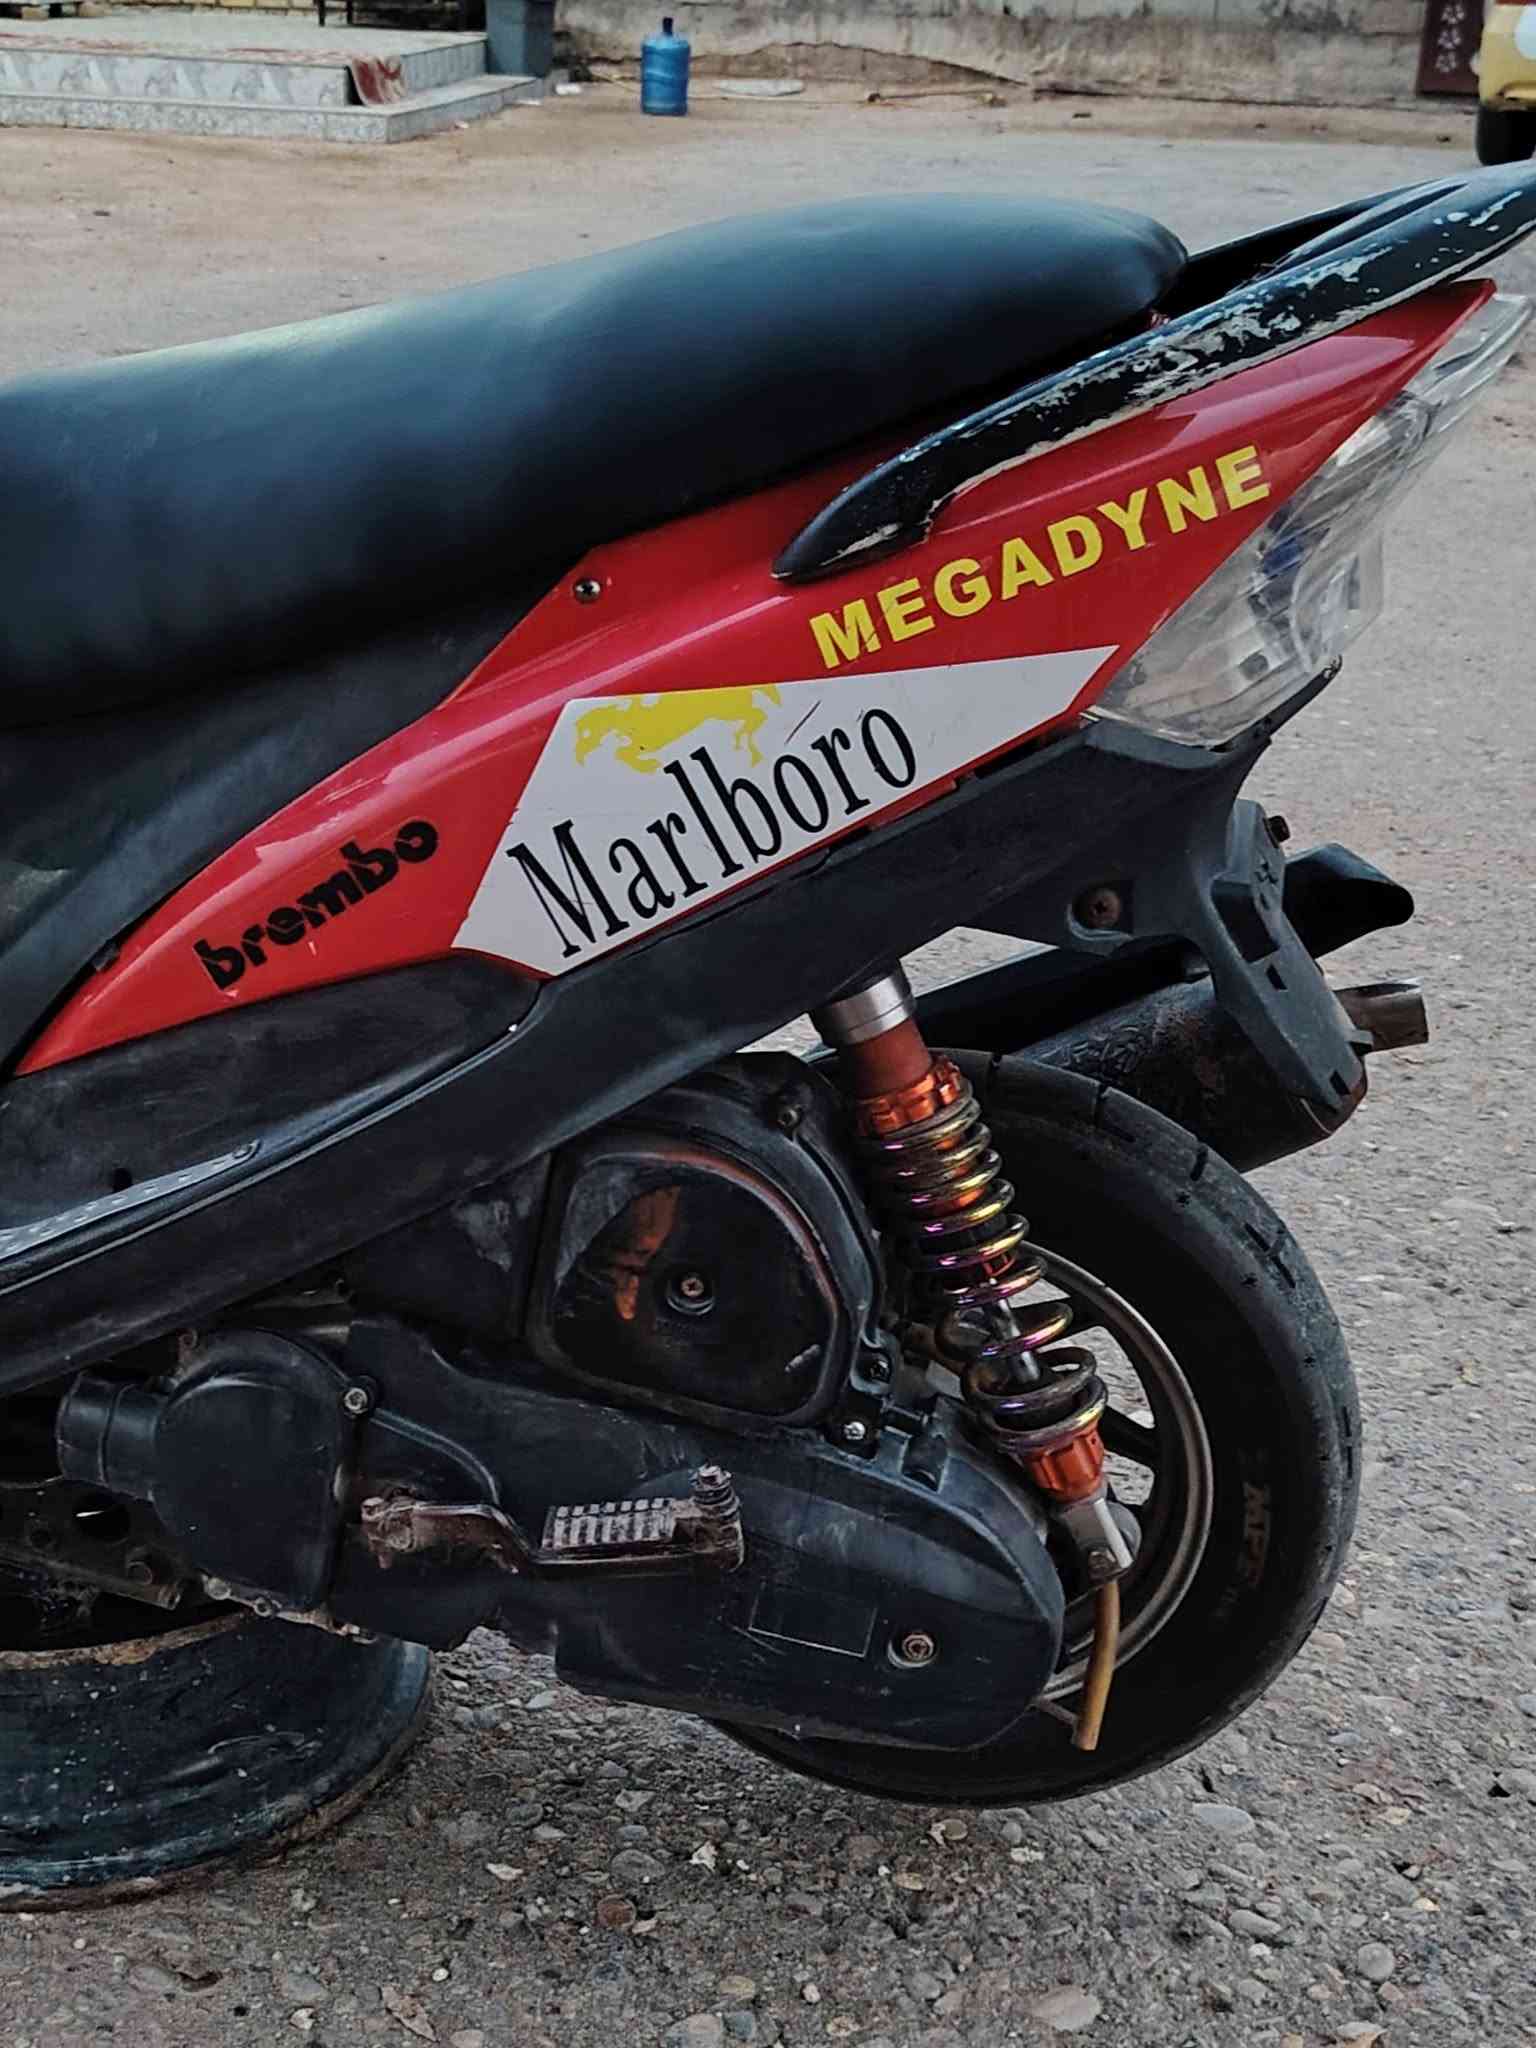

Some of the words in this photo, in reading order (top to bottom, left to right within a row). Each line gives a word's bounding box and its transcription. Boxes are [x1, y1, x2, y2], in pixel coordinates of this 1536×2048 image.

[809, 445, 1271, 668] MEGADYNE
[194, 820, 438, 990] brembo
[506, 708, 917, 958] Marlboro
